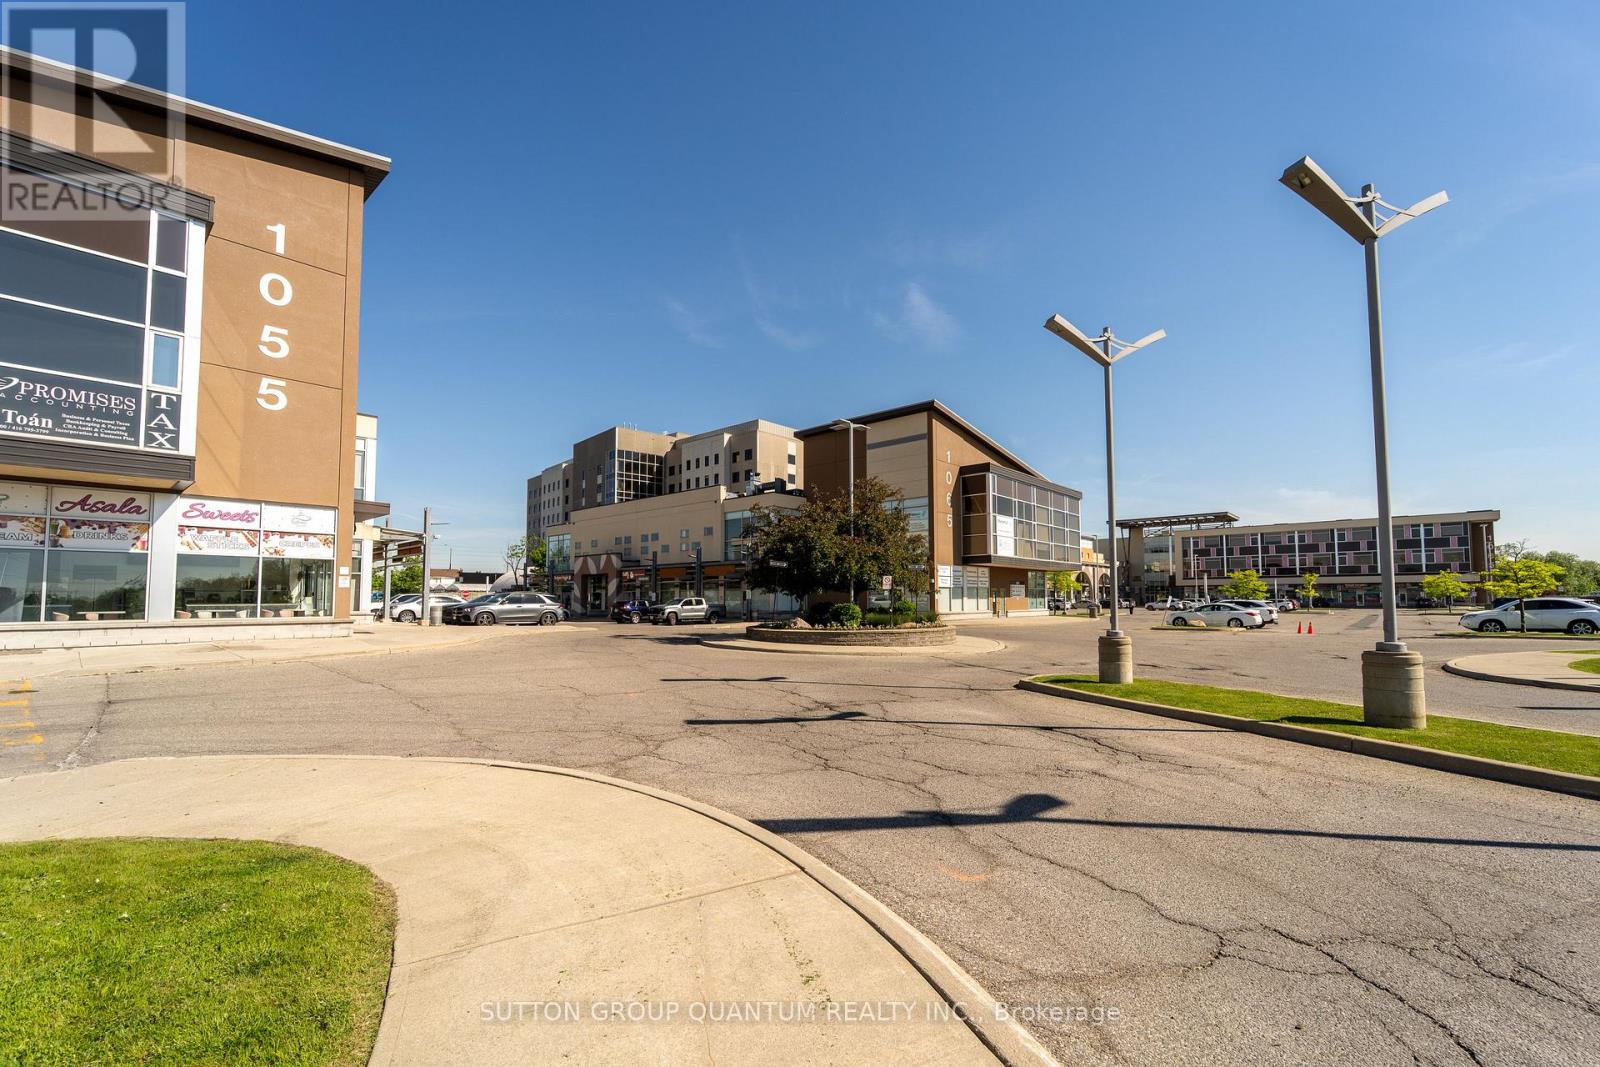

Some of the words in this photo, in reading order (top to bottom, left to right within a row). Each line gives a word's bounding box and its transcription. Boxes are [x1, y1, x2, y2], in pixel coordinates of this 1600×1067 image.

[0, 393, 134, 417] ACCOUNTING
[19, 381, 136, 410] PROMISES
[2, 409, 53, 429] Toán
[147, 392, 178, 449] TAX
[55, 494, 148, 515] Asala
[182, 503, 259, 523] Sweets
[72, 530, 130, 541] DRINKS
